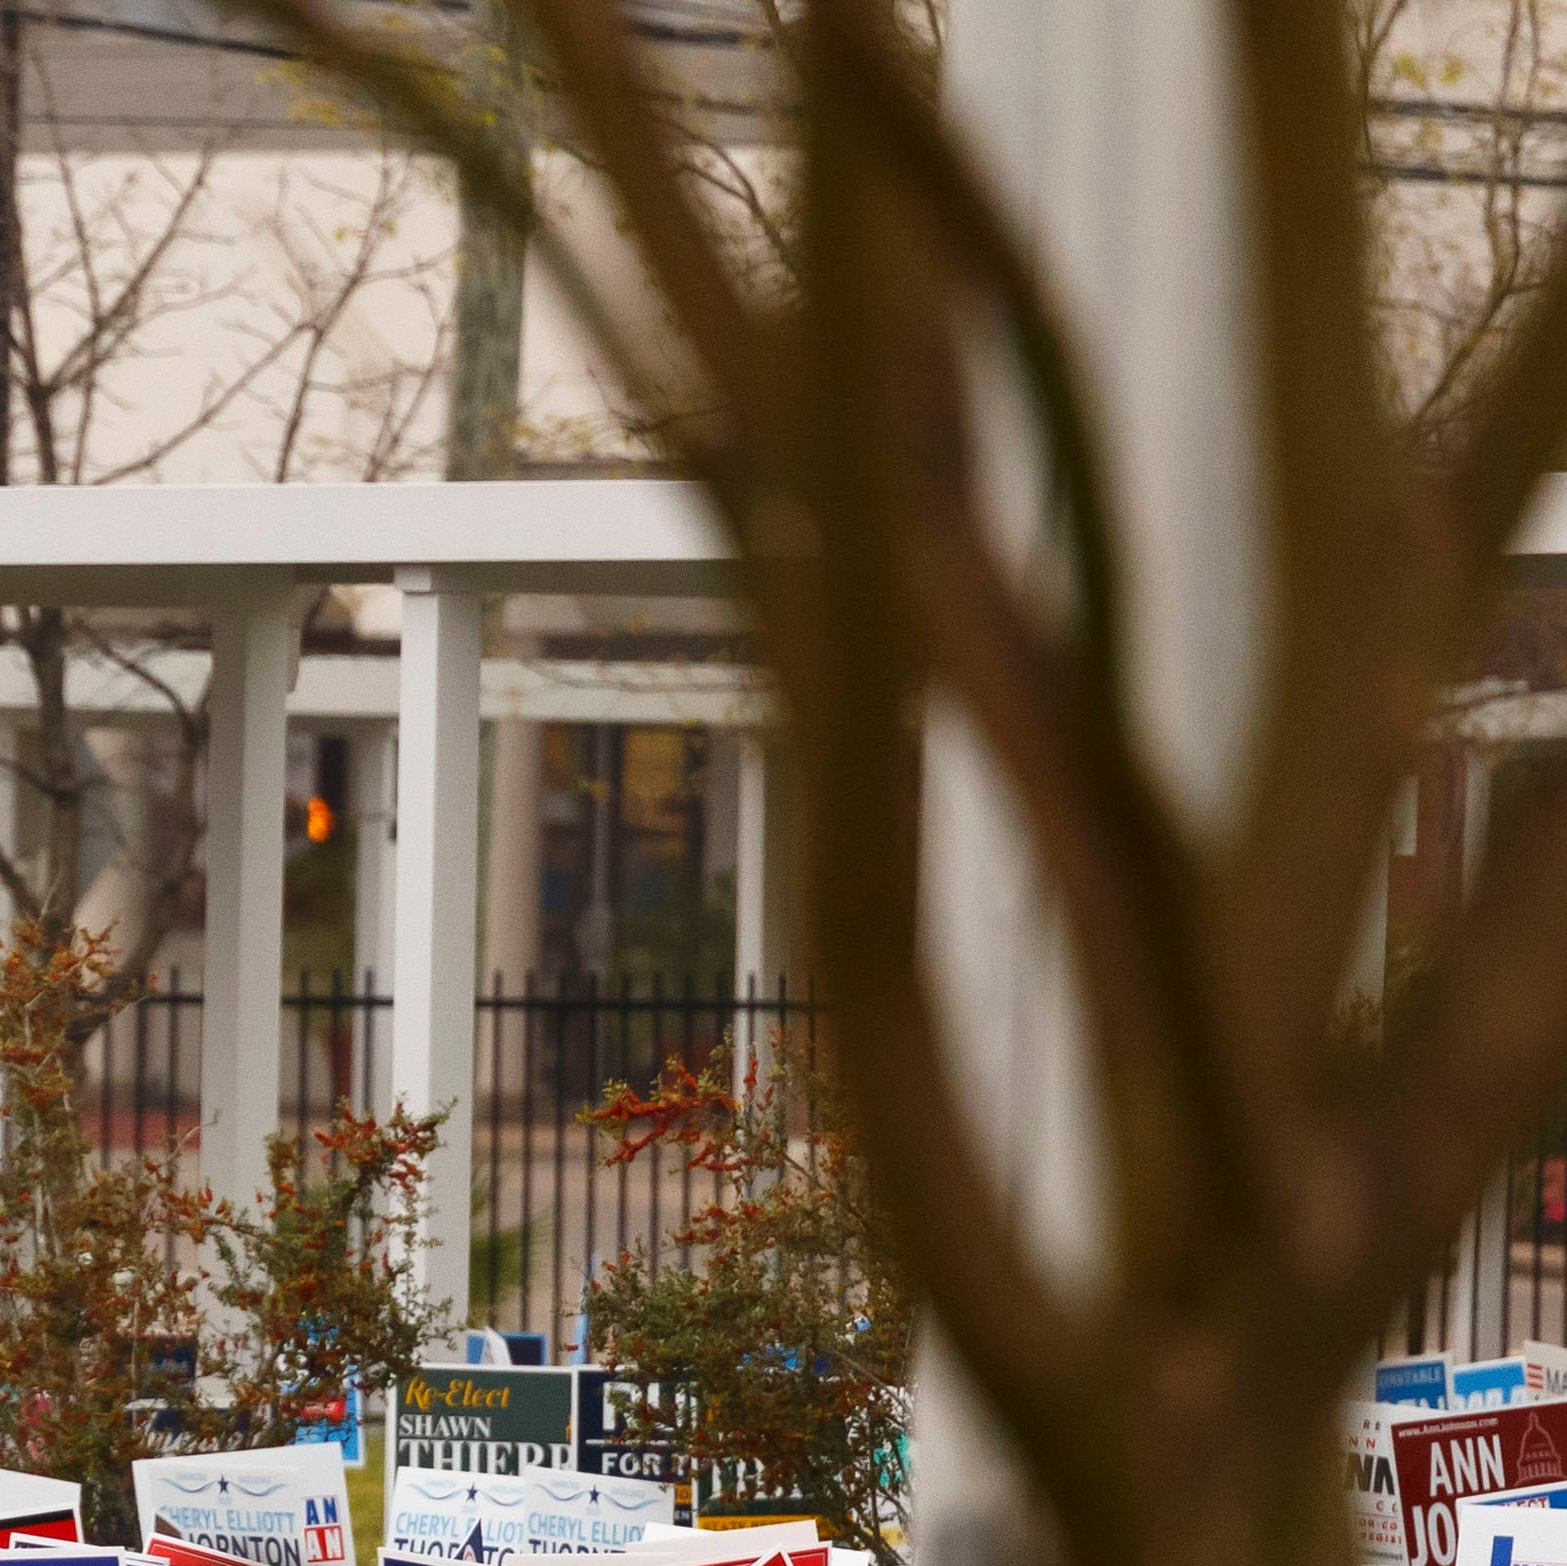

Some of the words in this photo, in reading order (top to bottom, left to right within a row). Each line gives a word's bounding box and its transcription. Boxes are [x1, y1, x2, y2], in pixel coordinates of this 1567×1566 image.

[405, 1375, 511, 1412] Re-Elect
[398, 1413, 492, 1439] SHAWN
[1429, 1433, 1506, 1498] ANN
[227, 1510, 296, 1534] ELLIOTT
[395, 1511, 465, 1542] CHERYL
[527, 1511, 587, 1542] CHERYL
